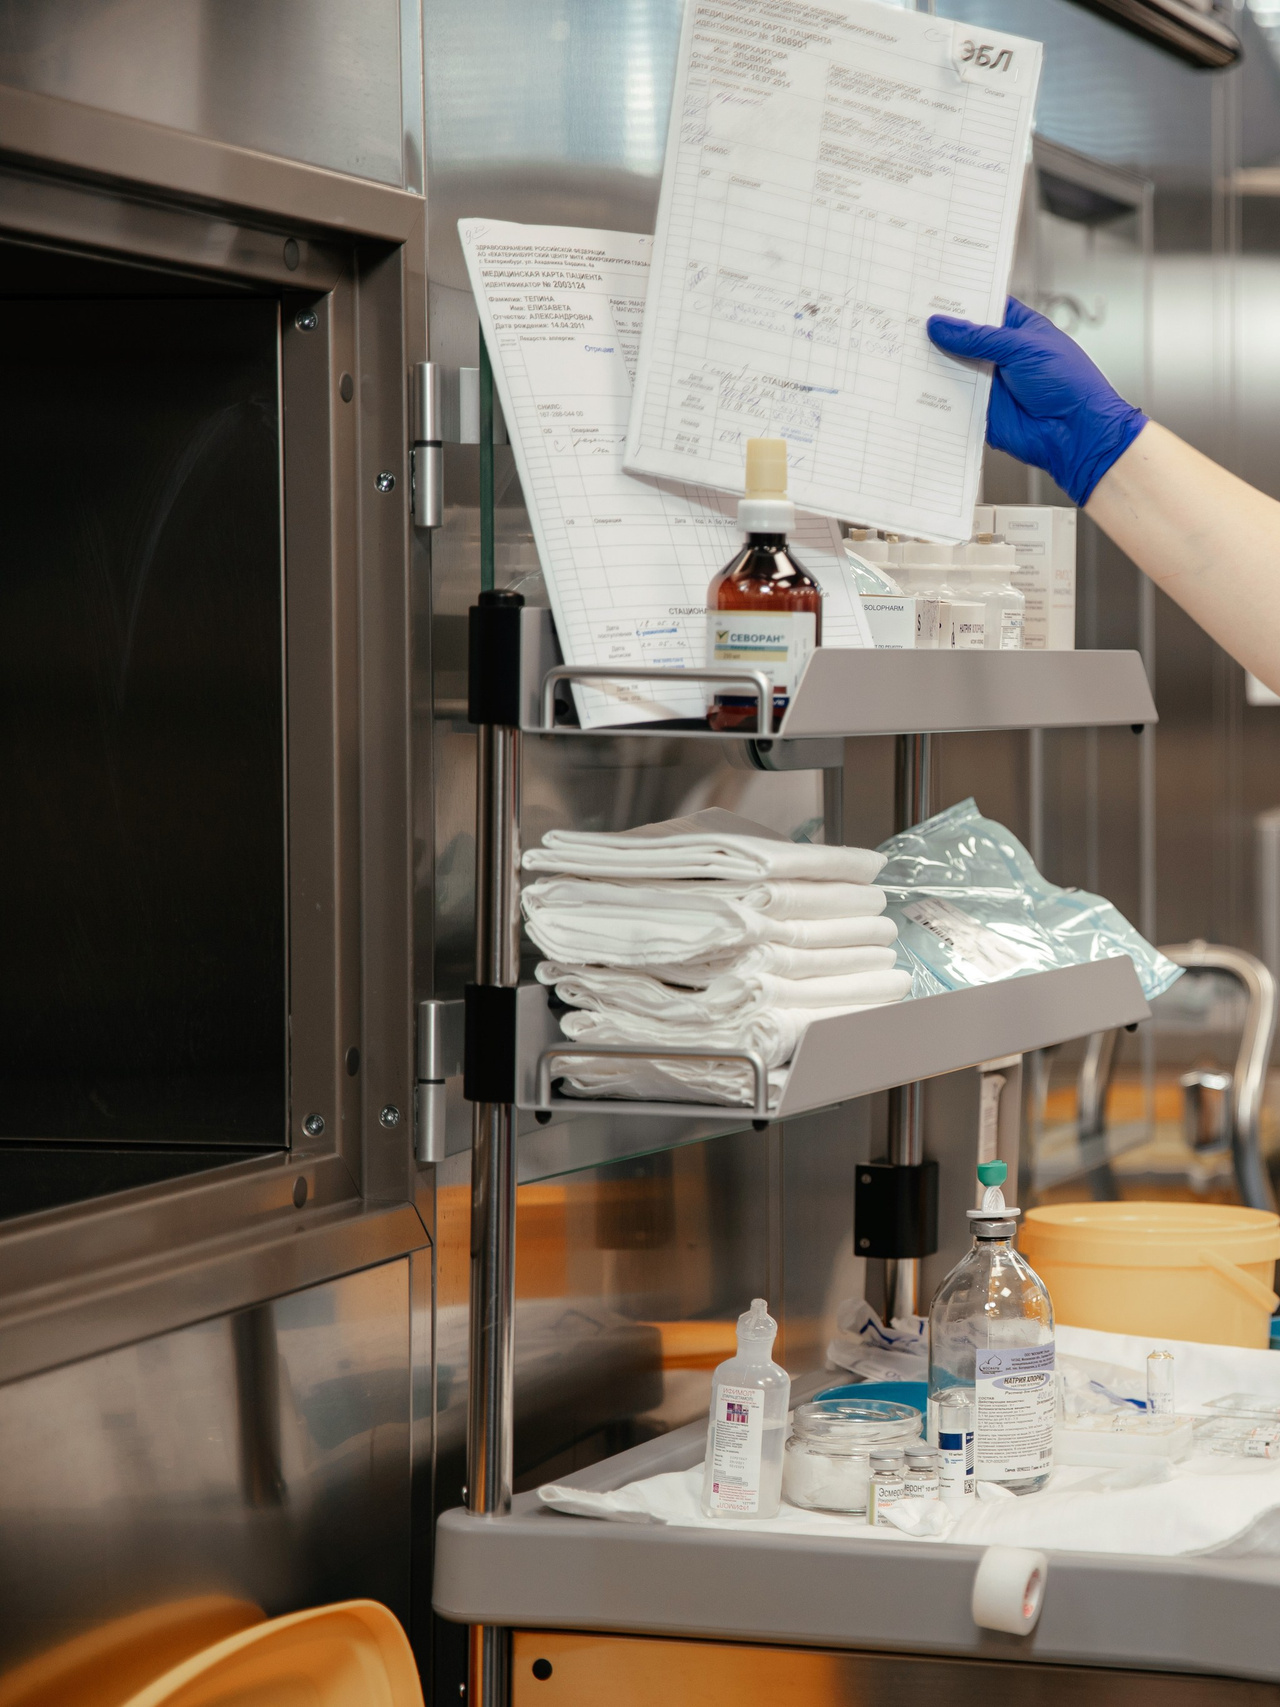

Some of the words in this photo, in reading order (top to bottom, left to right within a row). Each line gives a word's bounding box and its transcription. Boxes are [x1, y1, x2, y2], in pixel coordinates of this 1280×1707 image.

[697, 8, 760, 28] МЕДИЦИНСКАЯ
[761, 22, 788, 35] КАРТА
[789, 28, 832, 46] ПАЦИЕНТА
[695, 19, 757, 38] ИДЕНТИФИКАТОР
[758, 32, 769, 41] №
[771, 35, 808, 50] 1808901
[958, 38, 1014, 73] ЭБЛ
[690, 61, 709, 70] Дата
[730, 60, 787, 79] КИРИЛЛОВНА
[481, 269, 540, 279] МЕДИЦИНСКАЯ
[541, 271, 565, 279] КАРТА
[566, 271, 604, 281] ПАЦИЕНТА
[485, 280, 542, 289] ИДЕНТИФИКАТОР
[542, 280, 552, 289] №
[552, 280, 587, 290] 2003124
[527, 304, 572, 312] ЕЛИЗАВЕТА
[529, 313, 594, 321] АЛЕКСАНДРОВНА
[494, 322, 511, 331] Дата
[550, 321, 586, 330] 14.04.2011
[1003, 1376, 1027, 1385] НАТРИЯ
[1027, 1373, 1045, 1383] ХЛОРИД
